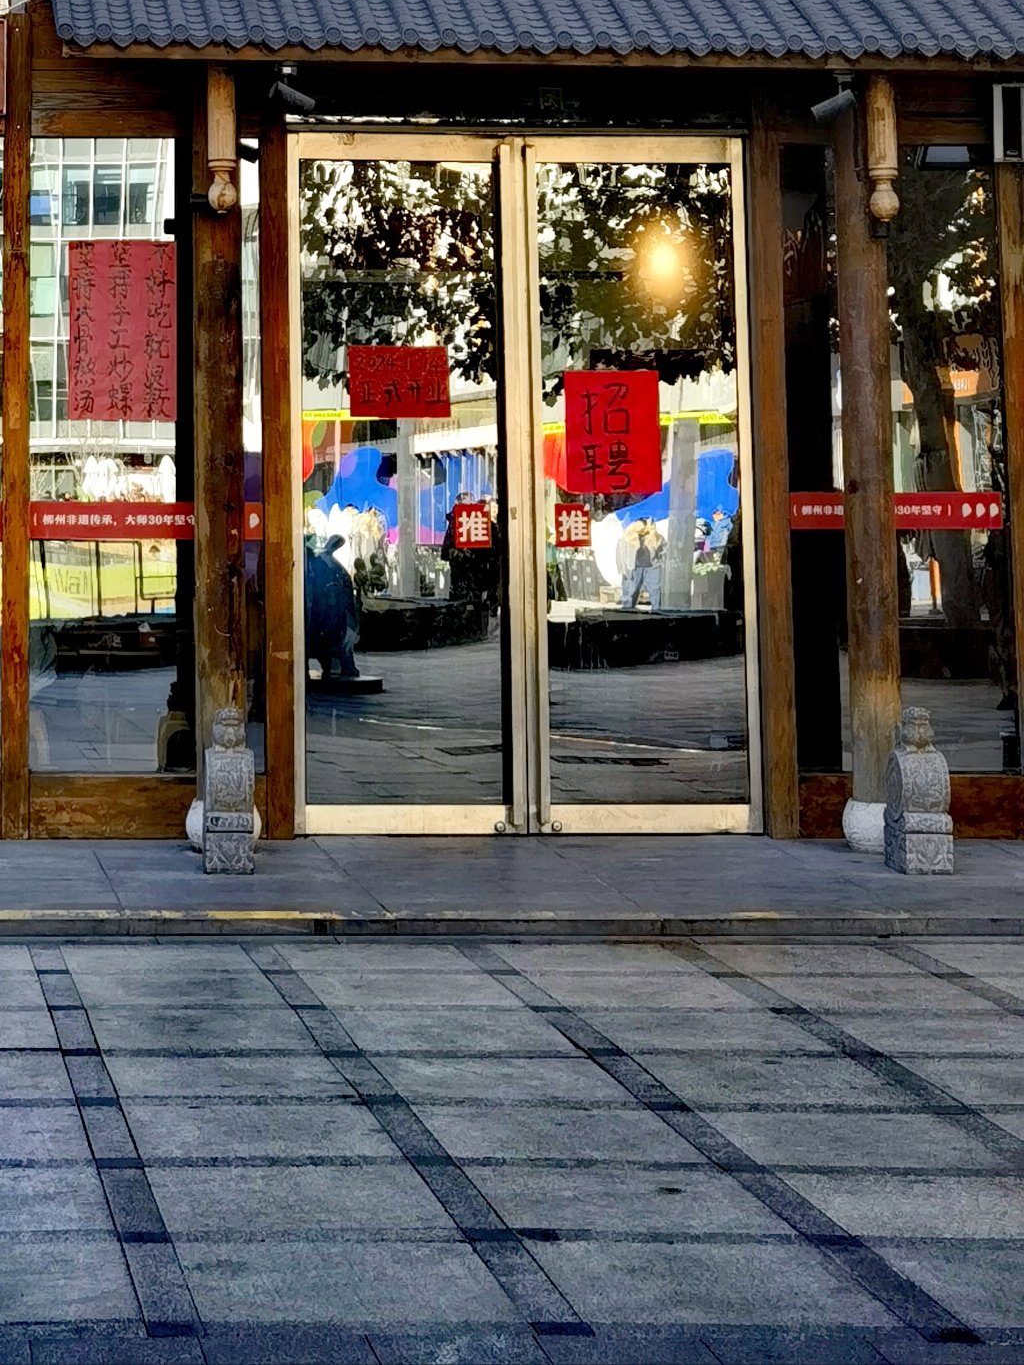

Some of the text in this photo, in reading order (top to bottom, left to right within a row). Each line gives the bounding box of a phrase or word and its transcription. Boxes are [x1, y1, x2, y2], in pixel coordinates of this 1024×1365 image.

[580, 382, 633, 491] 招聘
[458, 510, 490, 543] 推
[558, 509, 590, 542] 推
